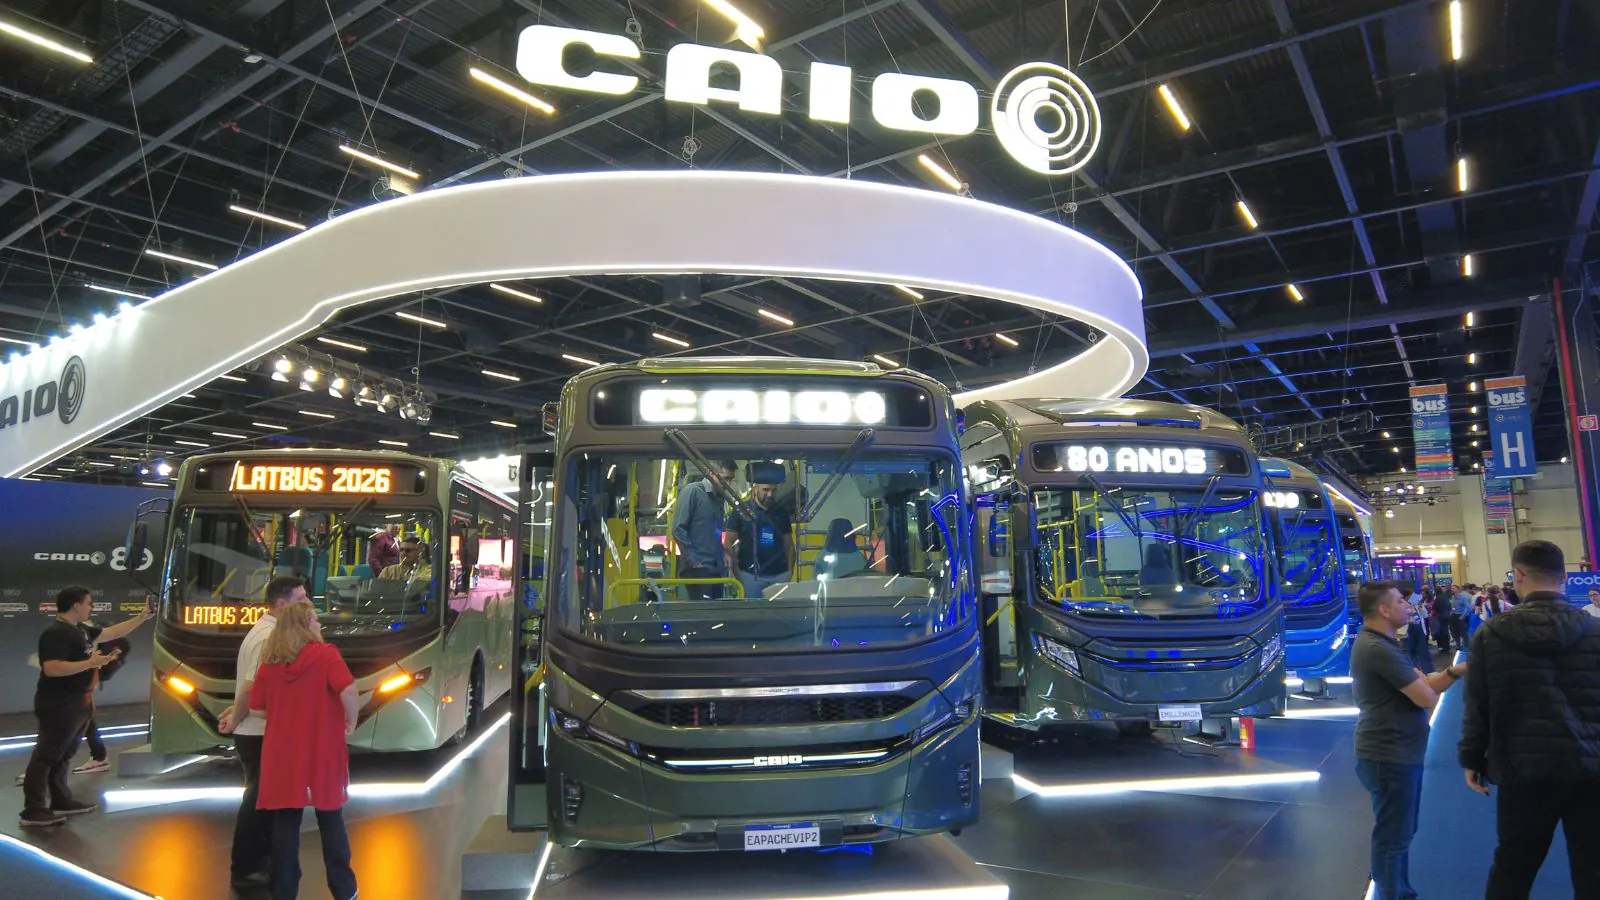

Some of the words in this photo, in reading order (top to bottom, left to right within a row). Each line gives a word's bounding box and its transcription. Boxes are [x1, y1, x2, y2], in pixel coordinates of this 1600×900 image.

[516, 24, 979, 135] CAIO
[1488, 391, 1525, 405] bus
[1067, 446, 1109, 472] 80
[1115, 447, 1207, 474] ANOS
[1501, 431, 1527, 468] H
[236, 465, 323, 491] LATBUS
[332, 468, 391, 492] 2026
[34, 552, 91, 561] CAIO
[184, 606, 236, 625] LATBUS
[240, 606, 270, 625] 20
[747, 832, 818, 846] EAPACHEVIP2
